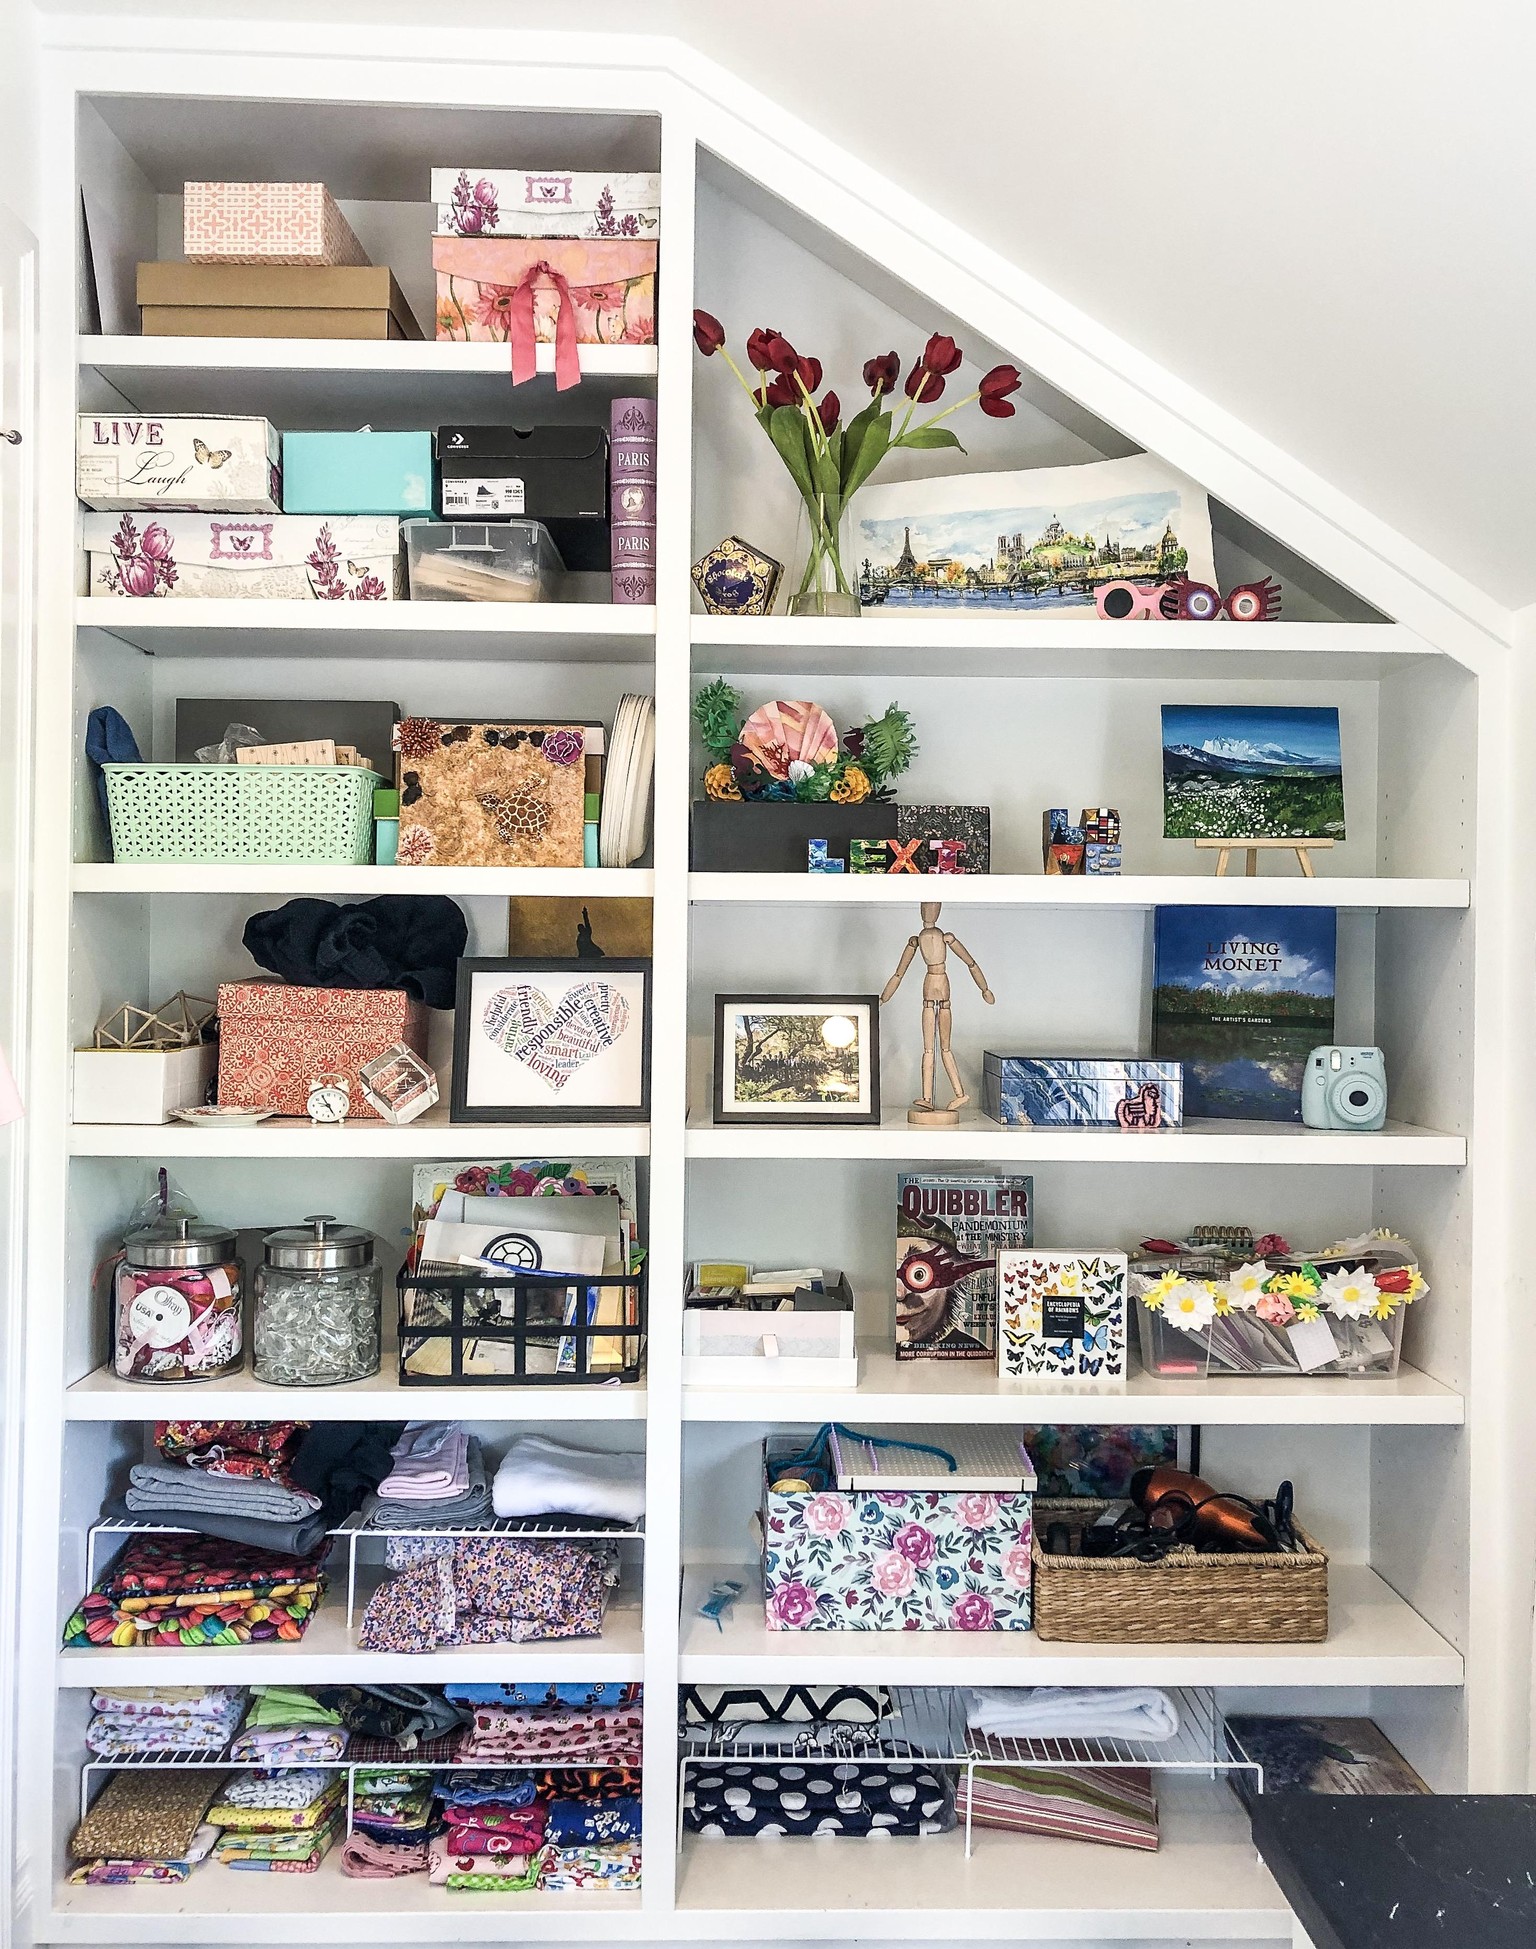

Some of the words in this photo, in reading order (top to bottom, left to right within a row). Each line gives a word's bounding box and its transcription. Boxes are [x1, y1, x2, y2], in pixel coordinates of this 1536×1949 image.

[93, 421, 165, 446] LIVE
[618, 452, 650, 467] PARIS
[104, 450, 194, 495] Laugh
[618, 537, 650, 551] PARIS
[1206, 942, 1280, 955] LIVING
[1203, 958, 1282, 971] MONET
[567, 984, 591, 1001] sweet
[598, 984, 610, 1014] pretty
[485, 994, 507, 1027] helpful
[488, 1000, 518, 1041] considerate
[517, 985, 538, 1036] friendly
[515, 998, 584, 1062] responsible
[565, 1019, 593, 1038] devoted
[583, 998, 613, 1047] creative
[503, 1018, 522, 1053] caring
[556, 1028, 601, 1053] beautiful
[544, 1044, 579, 1059] smart
[527, 1051, 571, 1088] loving
[555, 1058, 580, 1069] leader
[902, 1184, 1028, 1230] QUIBBLER
[951, 1220, 1028, 1232] PANDEMONIUM
[965, 1232, 982, 1241] THE
[984, 1231, 1028, 1241] MINISTRY
[135, 1303, 152, 1318] USA
[900, 1350, 915, 1358] MORE
[915, 1350, 949, 1358] CORRUPTION
[949, 1350, 956, 1358] IN
[956, 1350, 966, 1358] THE
